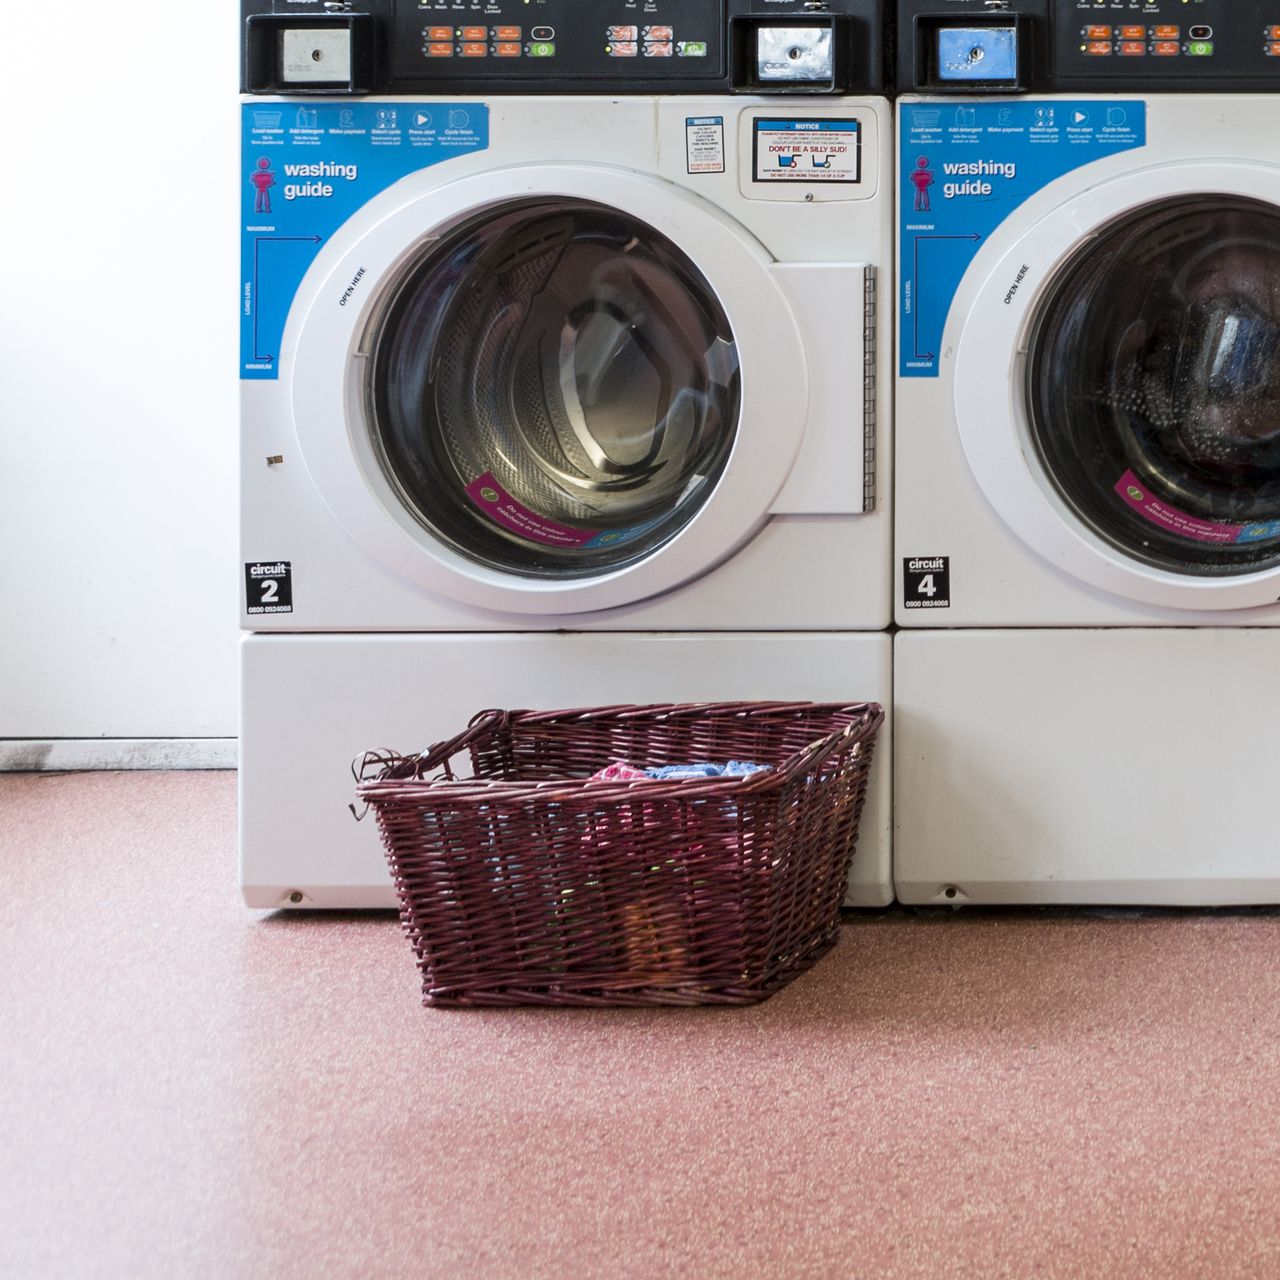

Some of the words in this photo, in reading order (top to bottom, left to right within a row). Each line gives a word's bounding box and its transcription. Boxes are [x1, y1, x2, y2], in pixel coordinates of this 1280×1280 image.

[284, 161, 357, 182] washing
[943, 159, 1016, 180] washing
[284, 182, 334, 200] guide
[943, 179, 992, 198] guide
[338, 287, 357, 307] OPEN
[352, 266, 367, 288] HERE
[1004, 284, 1020, 305] OPEN
[1017, 264, 1030, 287] HERE
[250, 563, 286, 574] circuit
[910, 557, 944, 569] circuit
[260, 580, 278, 602] 2
[918, 575, 936, 596] 4
